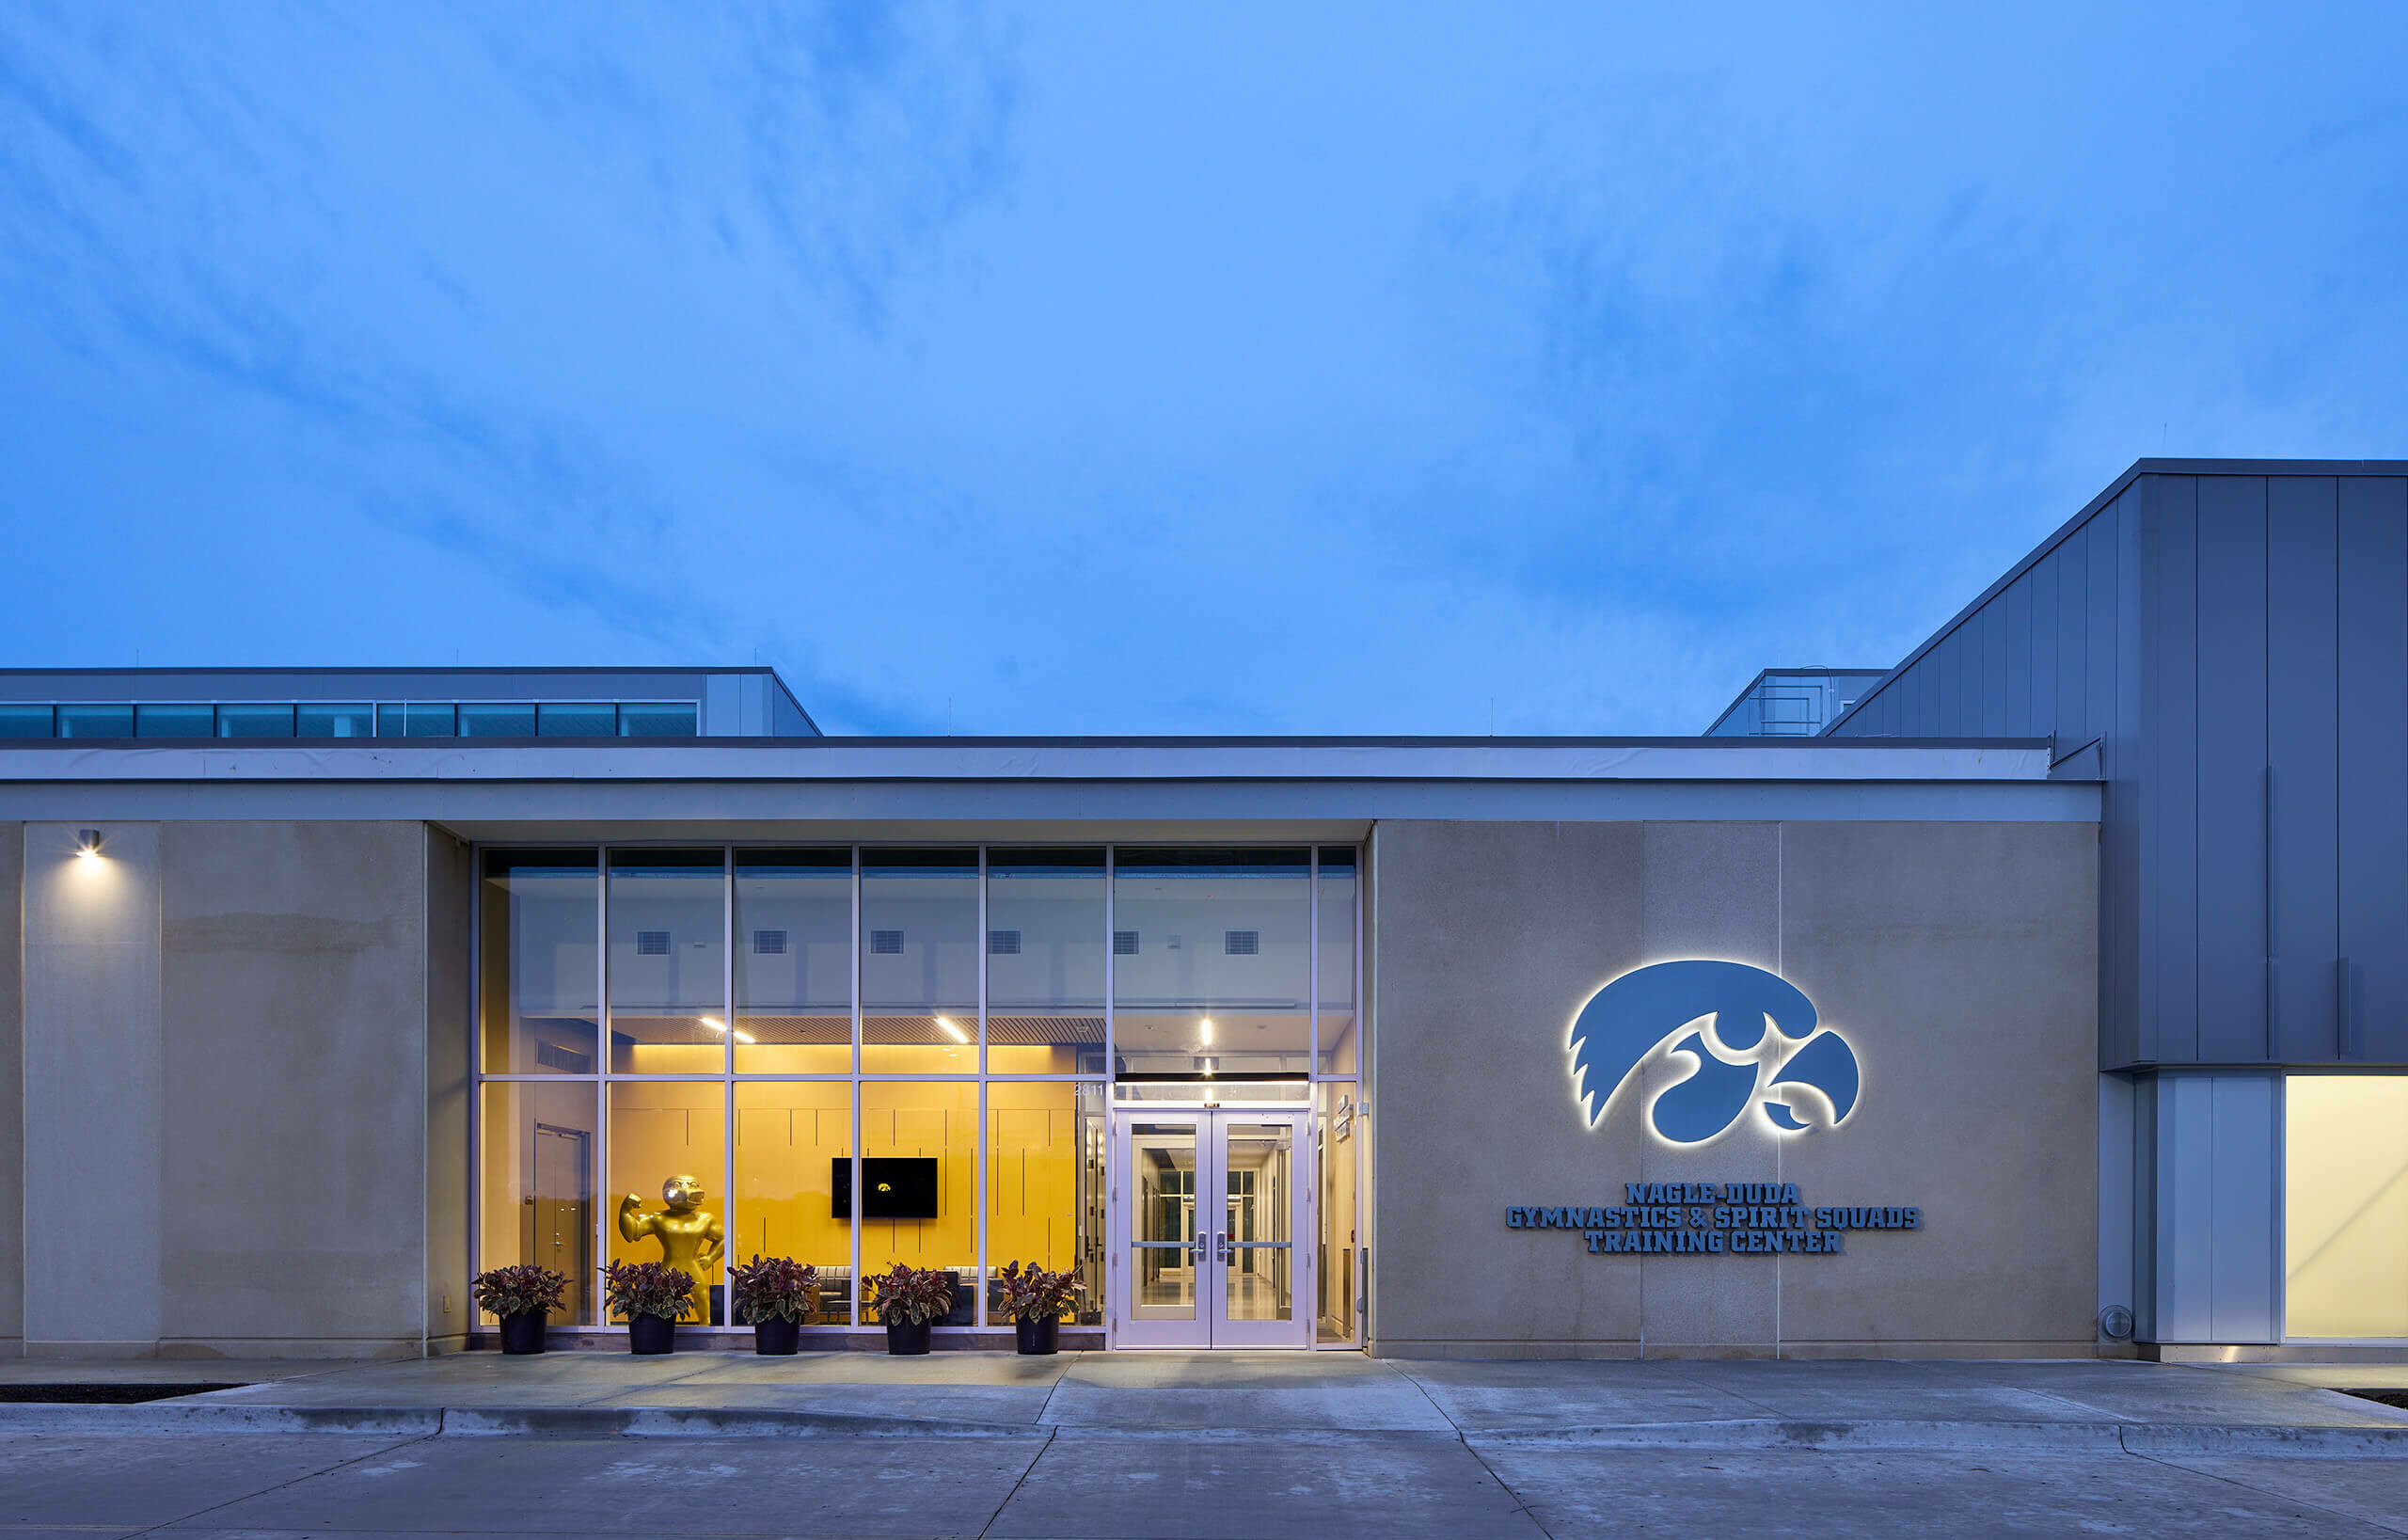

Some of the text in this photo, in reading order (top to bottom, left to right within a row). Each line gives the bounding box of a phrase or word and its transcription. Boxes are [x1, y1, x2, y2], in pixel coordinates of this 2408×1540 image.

[1073, 1083, 1103, 1097] 2811
[1624, 1182, 1800, 1205] NAGLE-DUDA
[1505, 1205, 1921, 1230] GYMNASTICS & SPIRIT SQUADS
[1584, 1230, 1841, 1253] TRAINING CENTER
